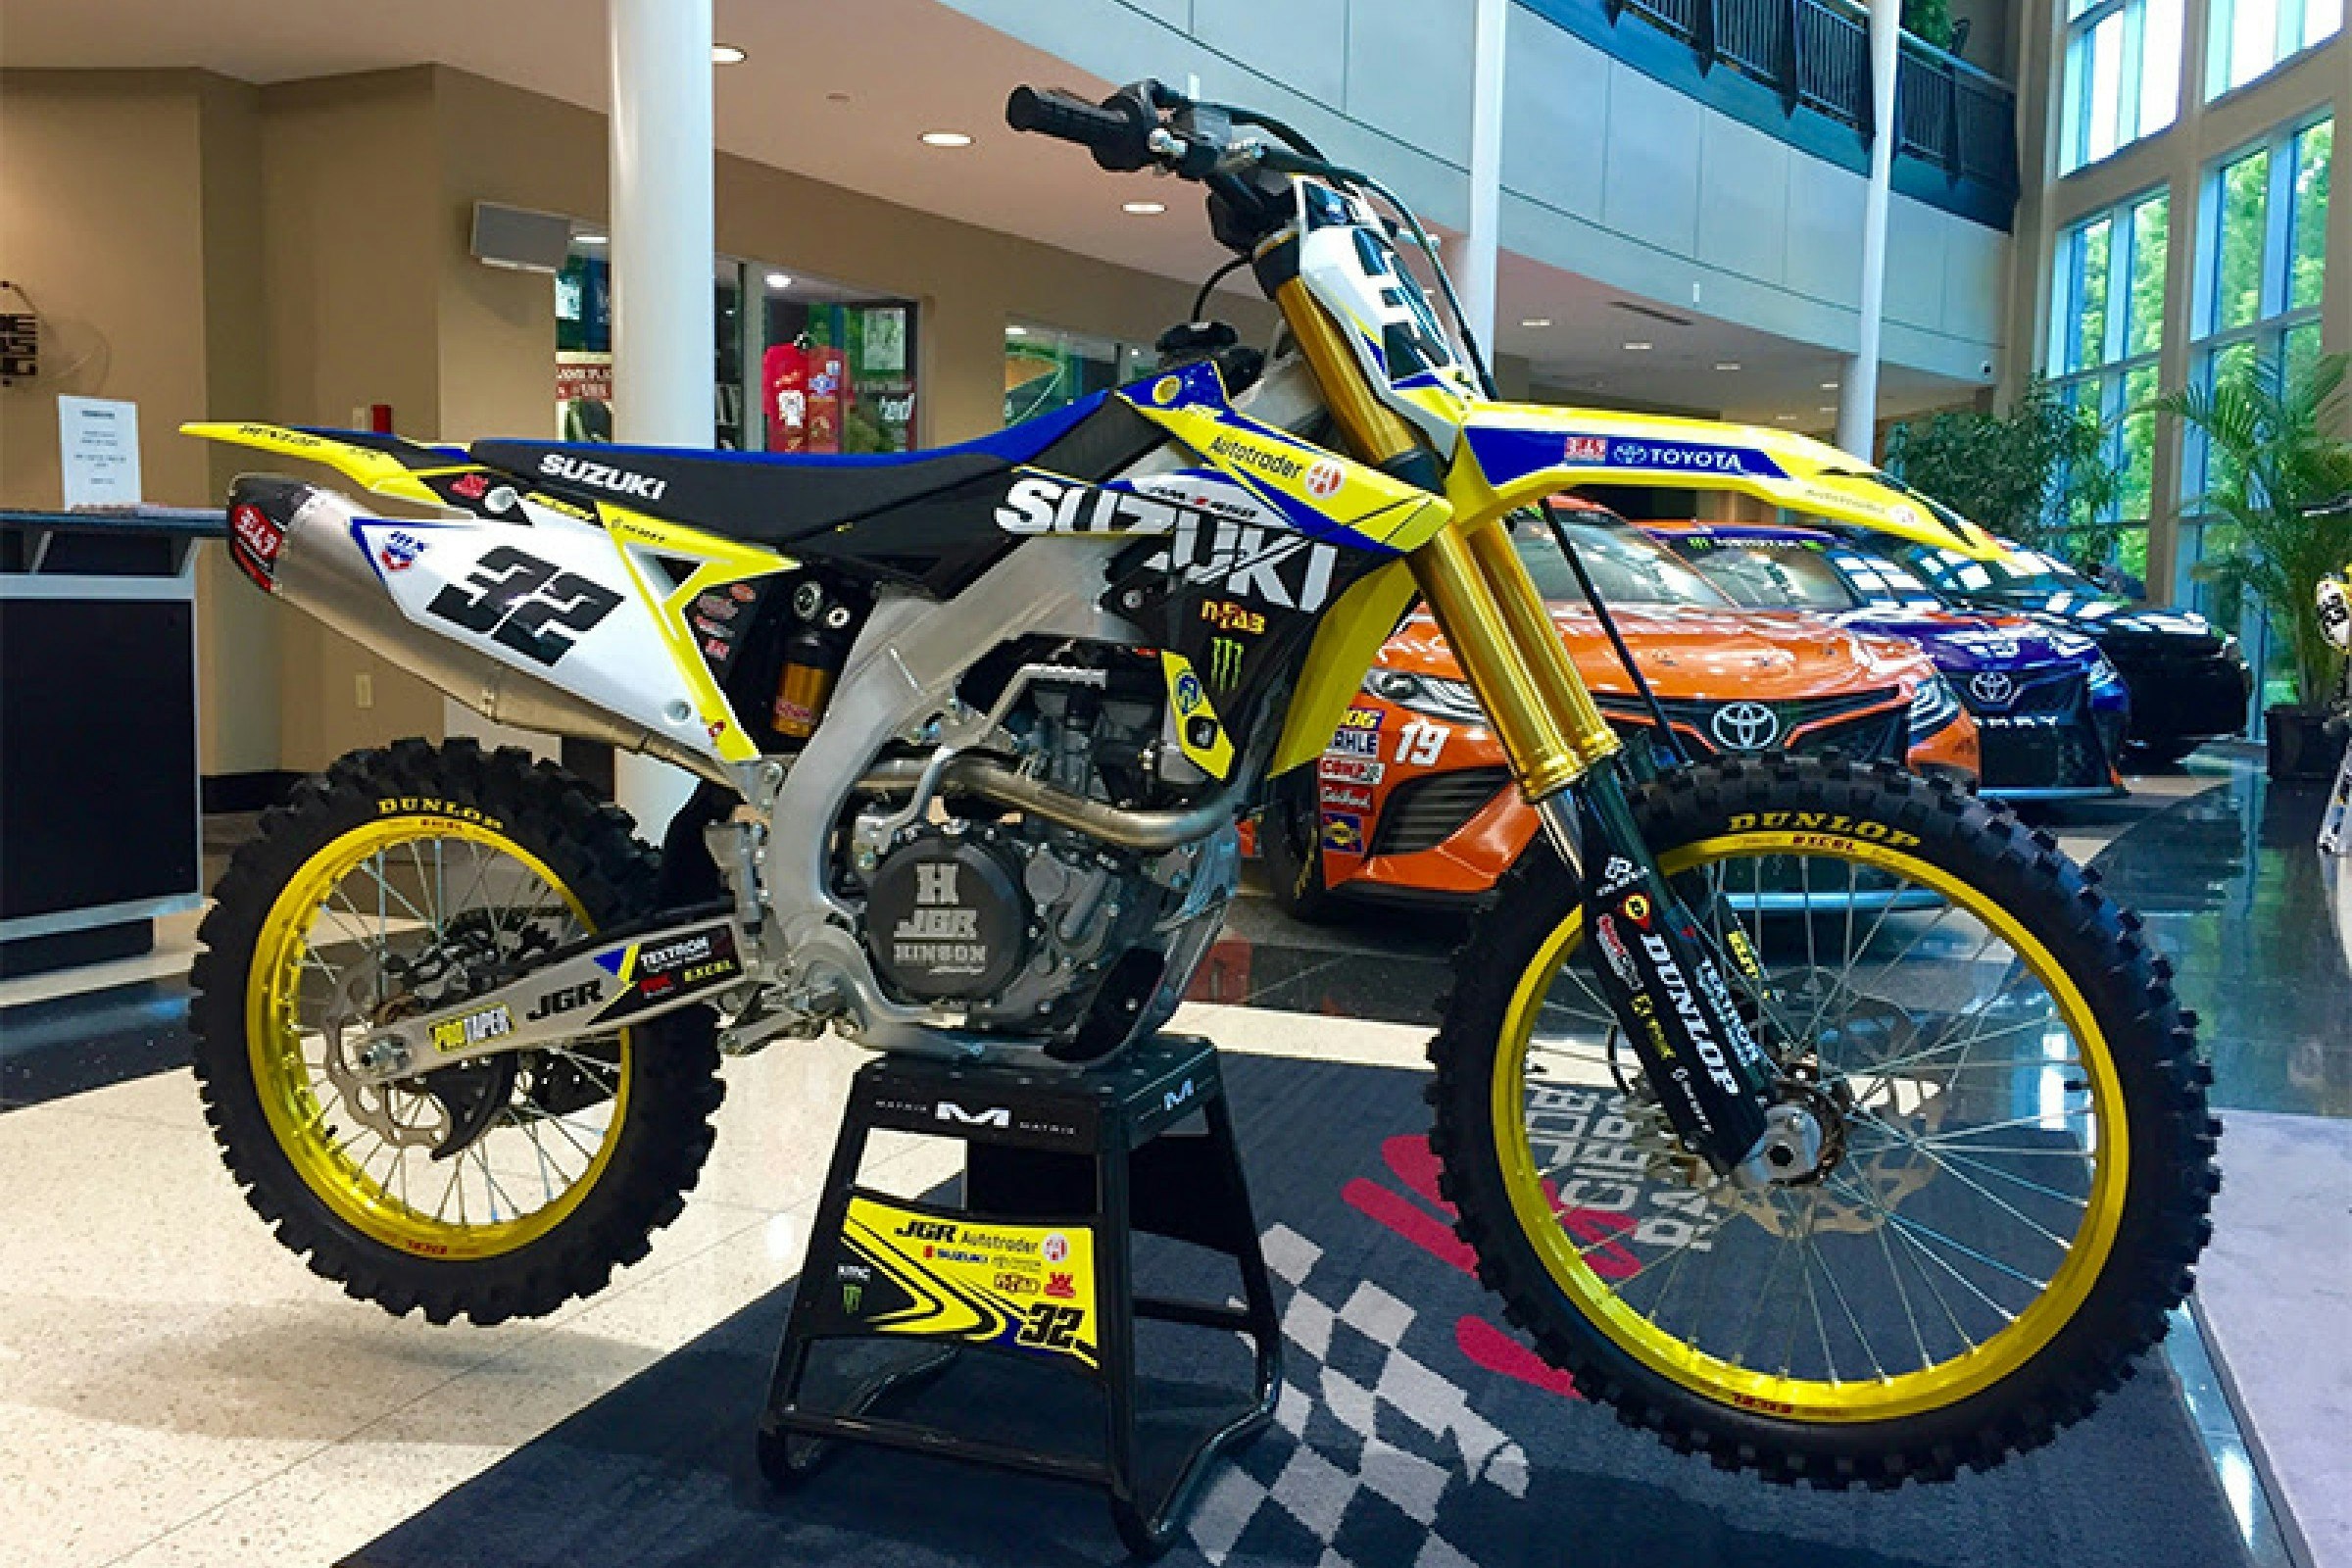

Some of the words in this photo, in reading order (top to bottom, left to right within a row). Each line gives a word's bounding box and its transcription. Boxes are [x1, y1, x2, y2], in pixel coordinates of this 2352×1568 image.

[538, 454, 668, 500] SUZUKI
[1208, 434, 1303, 480] Autotrader
[1648, 448, 1742, 471] TOYOTA
[994, 478, 1339, 613] SUZUKI
[425, 545, 626, 667] 32
[1332, 731, 1377, 753] AHLE
[1395, 722, 1450, 766] 19
[376, 797, 504, 830] DUNLOP
[1728, 811, 1922, 848] DUNLOP
[915, 862, 959, 905] H
[894, 908, 978, 940] JGR
[641, 936, 710, 966] TEXTRON
[893, 944, 987, 964] HINSON
[526, 978, 604, 1020] JGR
[1640, 933, 1741, 1096] DUNLOP
[1701, 956, 1761, 1061] TEXTRON
[894, 1220, 958, 1243] JGR
[959, 1231, 1039, 1254] Autotrader
[1015, 1301, 1086, 1350] 32
